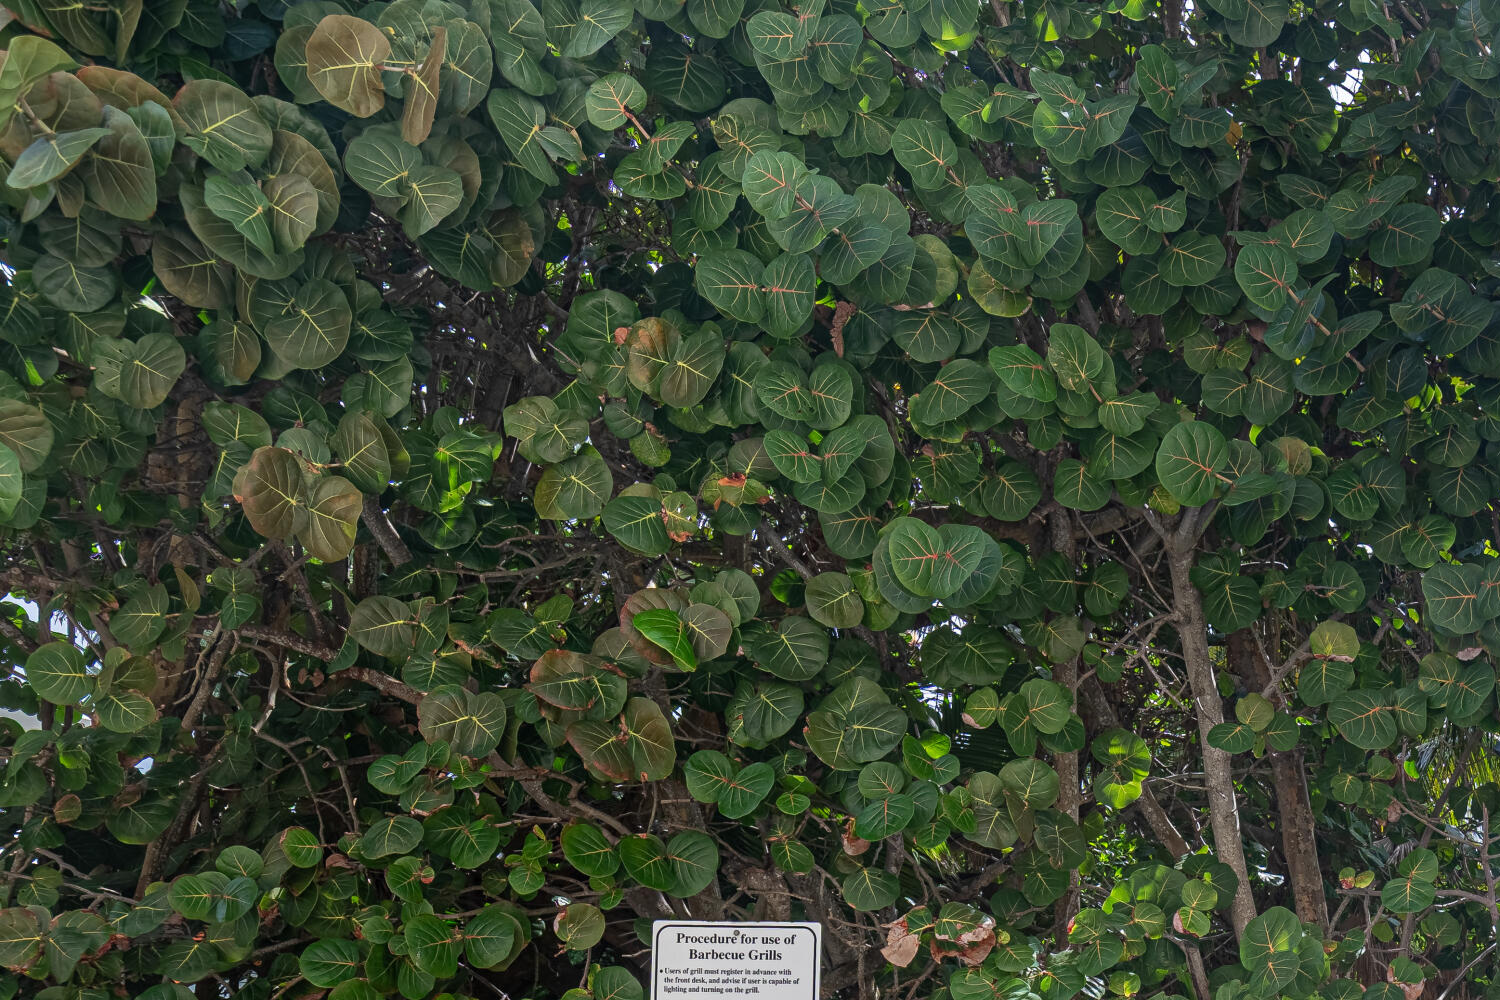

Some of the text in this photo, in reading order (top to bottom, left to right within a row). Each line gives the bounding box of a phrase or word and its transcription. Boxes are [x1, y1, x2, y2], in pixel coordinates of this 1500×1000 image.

[676, 933, 738, 944] Procedure
[740, 934, 758, 944] for
[783, 934, 796, 944] of
[689, 949, 783, 960] Barbecue Grills
[690, 968, 703, 976] grill
[720, 968, 743, 976] register
[691, 977, 708, 985] desk,
[721, 977, 740, 985] advise
[768, 978, 792, 986] capable
[663, 986, 687, 994] lighting
[701, 986, 724, 994] turning
[745, 987, 760, 995] grill.
